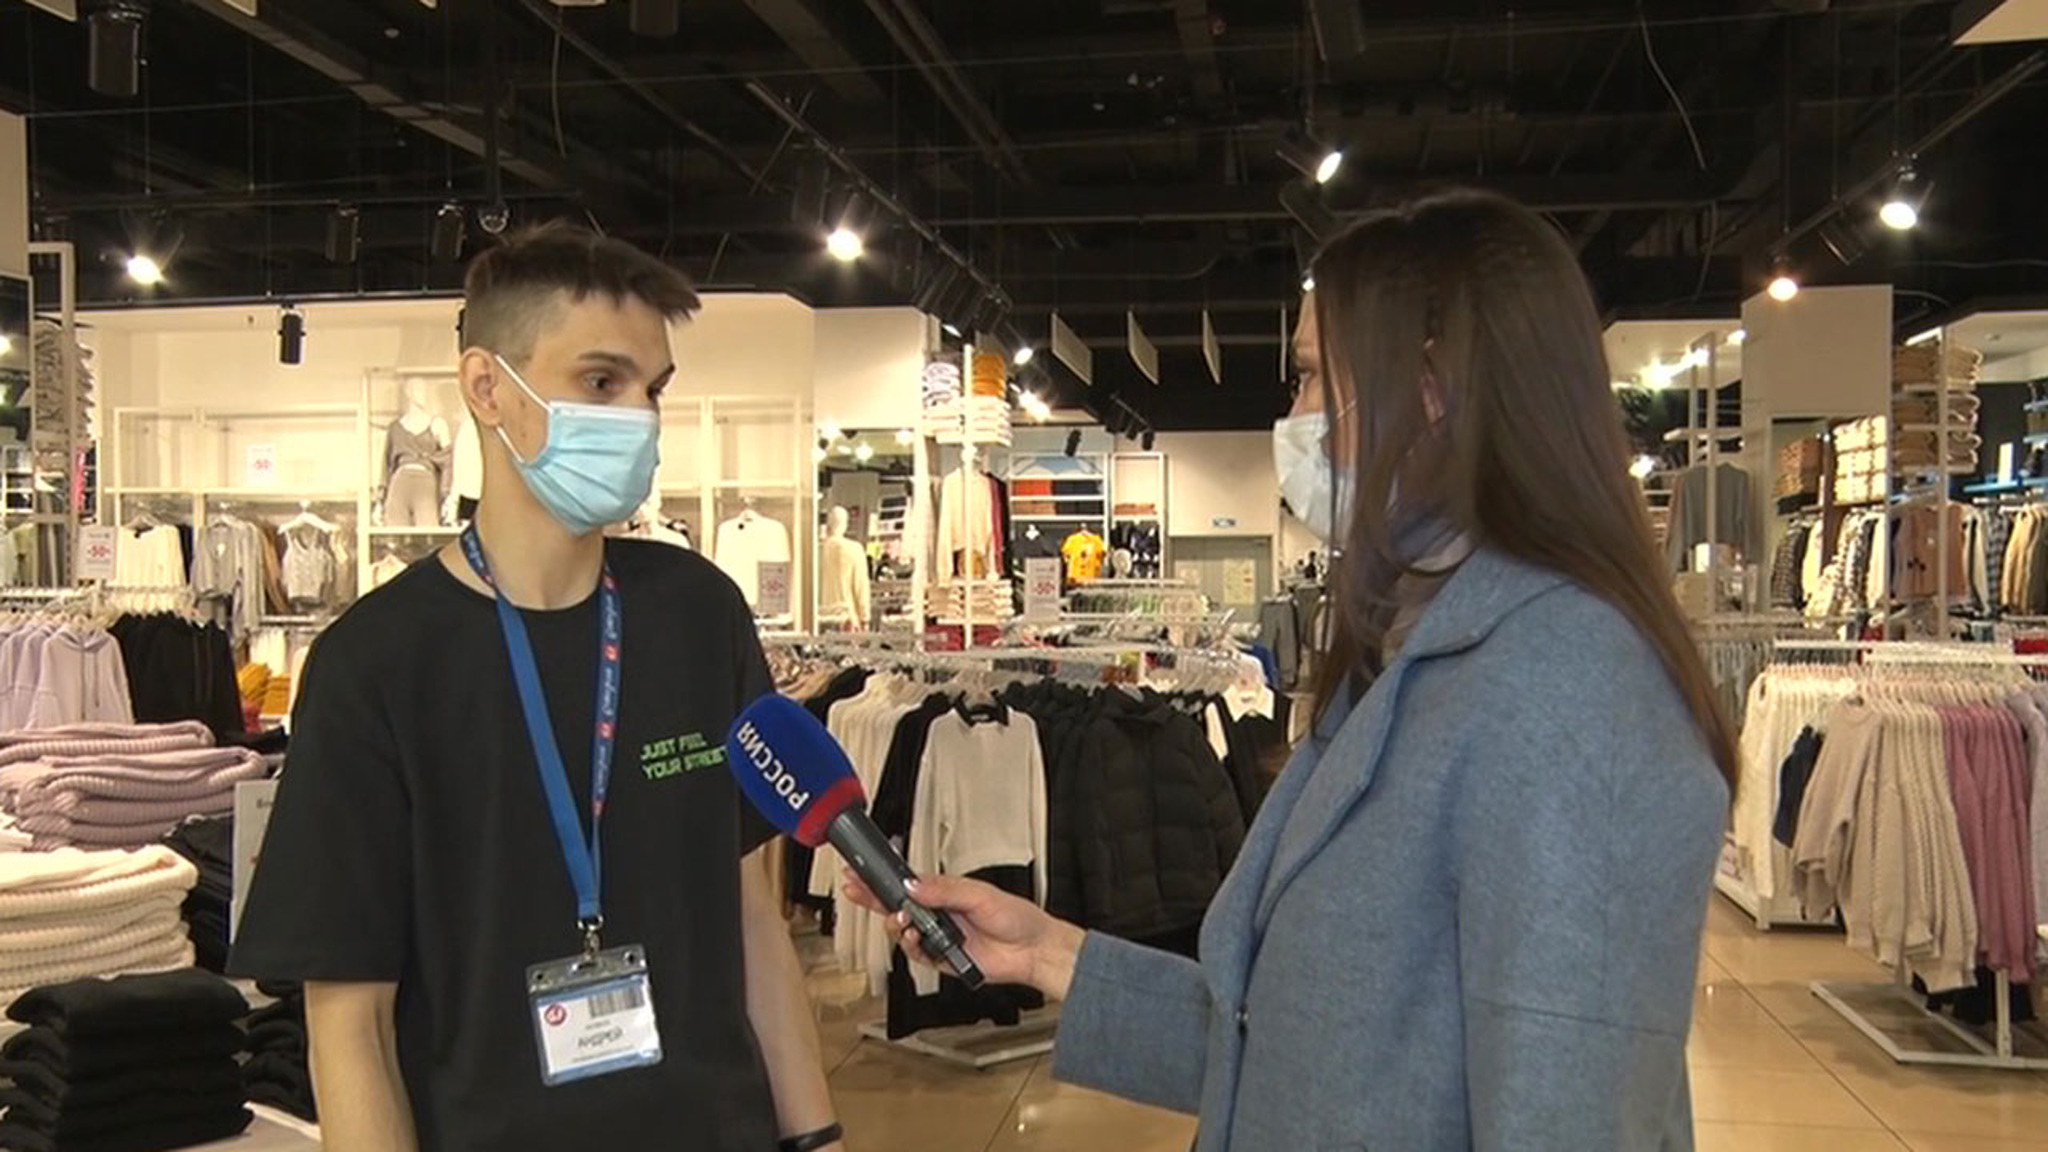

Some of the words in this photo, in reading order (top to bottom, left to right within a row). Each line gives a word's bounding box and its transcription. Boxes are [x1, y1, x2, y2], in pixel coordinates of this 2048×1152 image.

[640, 738, 677, 761] JUST
[642, 758, 682, 780] YOUR
[736, 721, 810, 810] РОССИЯ
